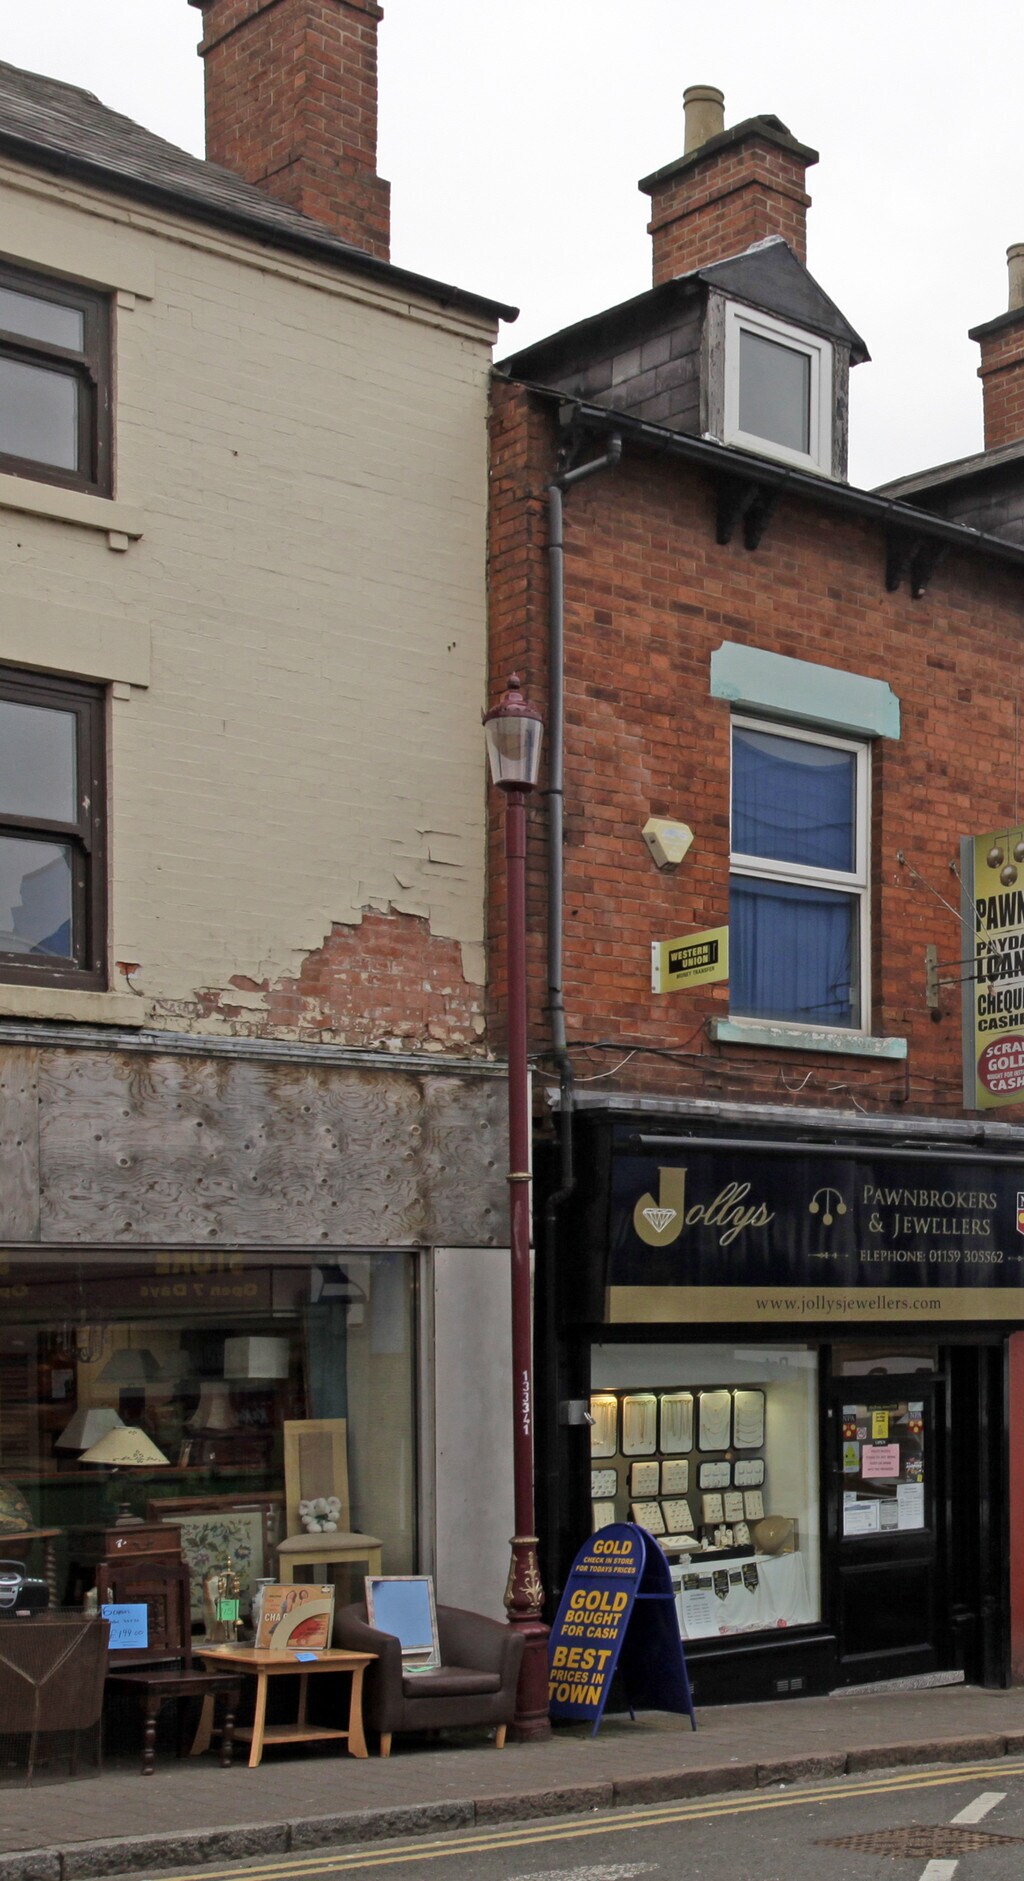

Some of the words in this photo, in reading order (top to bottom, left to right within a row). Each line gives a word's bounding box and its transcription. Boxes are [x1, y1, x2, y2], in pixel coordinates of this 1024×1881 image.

[670, 945, 709, 962] WESTERN
[682, 954, 709, 969] UNION
[863, 1184, 997, 1210] PAWNBROKERS
[633, 1167, 775, 1247] Jollys
[868, 1212, 885, 1233] &
[929, 1250, 961, 1263] 01159
[964, 1250, 1004, 1264] 305562
[756, 1295, 941, 1314] www.jollysjewellers.com
[593, 1539, 633, 1555] GOLD
[583, 1556, 604, 1564] CHECK
[613, 1557, 634, 1565] STORE
[590, 1565, 613, 1573] TODAYS
[613, 1566, 637, 1574] PRICES
[570, 1589, 628, 1612] GOLD
[565, 1609, 622, 1626] BOUGHT
[560, 1625, 583, 1637] FOR
[586, 1626, 618, 1640] CASH
[552, 1646, 612, 1671] BEST
[550, 1669, 588, 1684] PRICES
[592, 1672, 605, 1685] IN
[548, 1682, 602, 1706] TOWN
